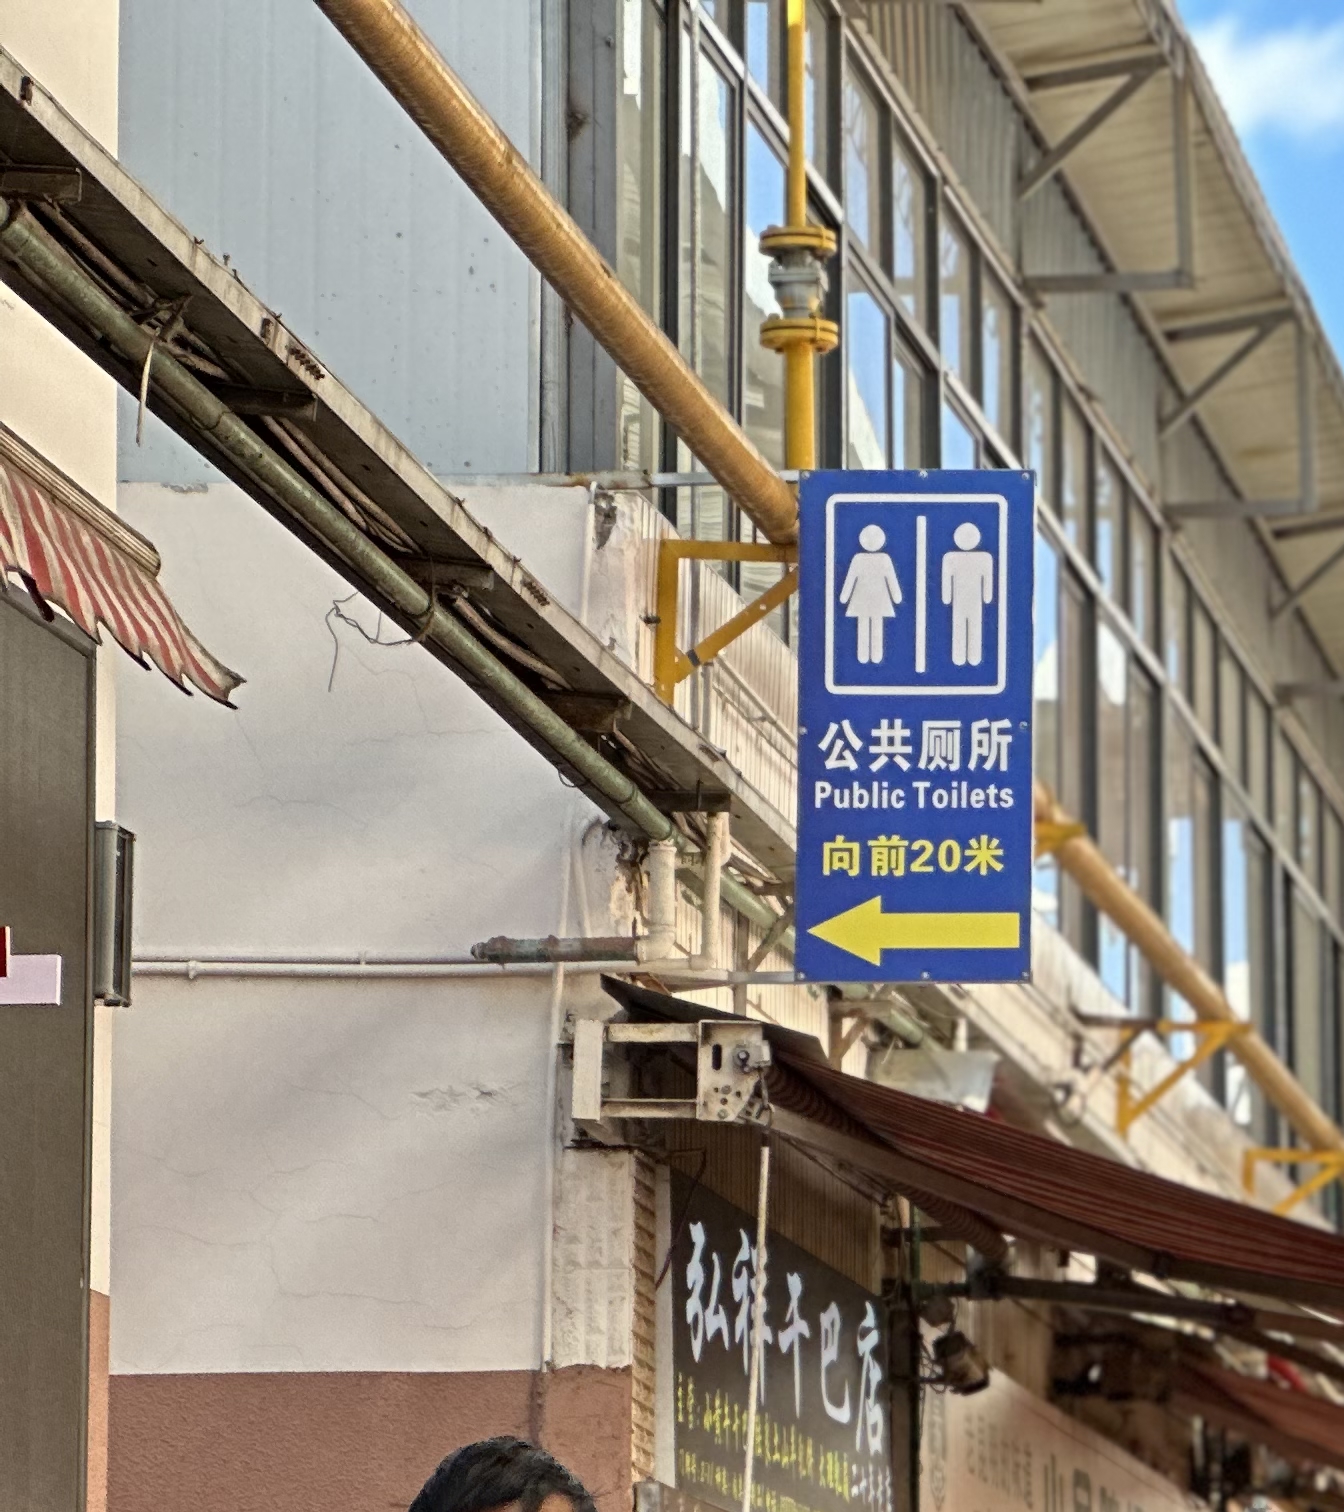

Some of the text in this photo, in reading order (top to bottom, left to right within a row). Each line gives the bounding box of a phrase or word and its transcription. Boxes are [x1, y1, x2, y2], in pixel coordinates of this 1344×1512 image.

[818, 718, 1013, 772] 公共厕所
[814, 781, 1014, 809] Public Toilets
[822, 834, 1005, 877] 向前20米
[685, 1221, 886, 1456] 弘祥干巴店
